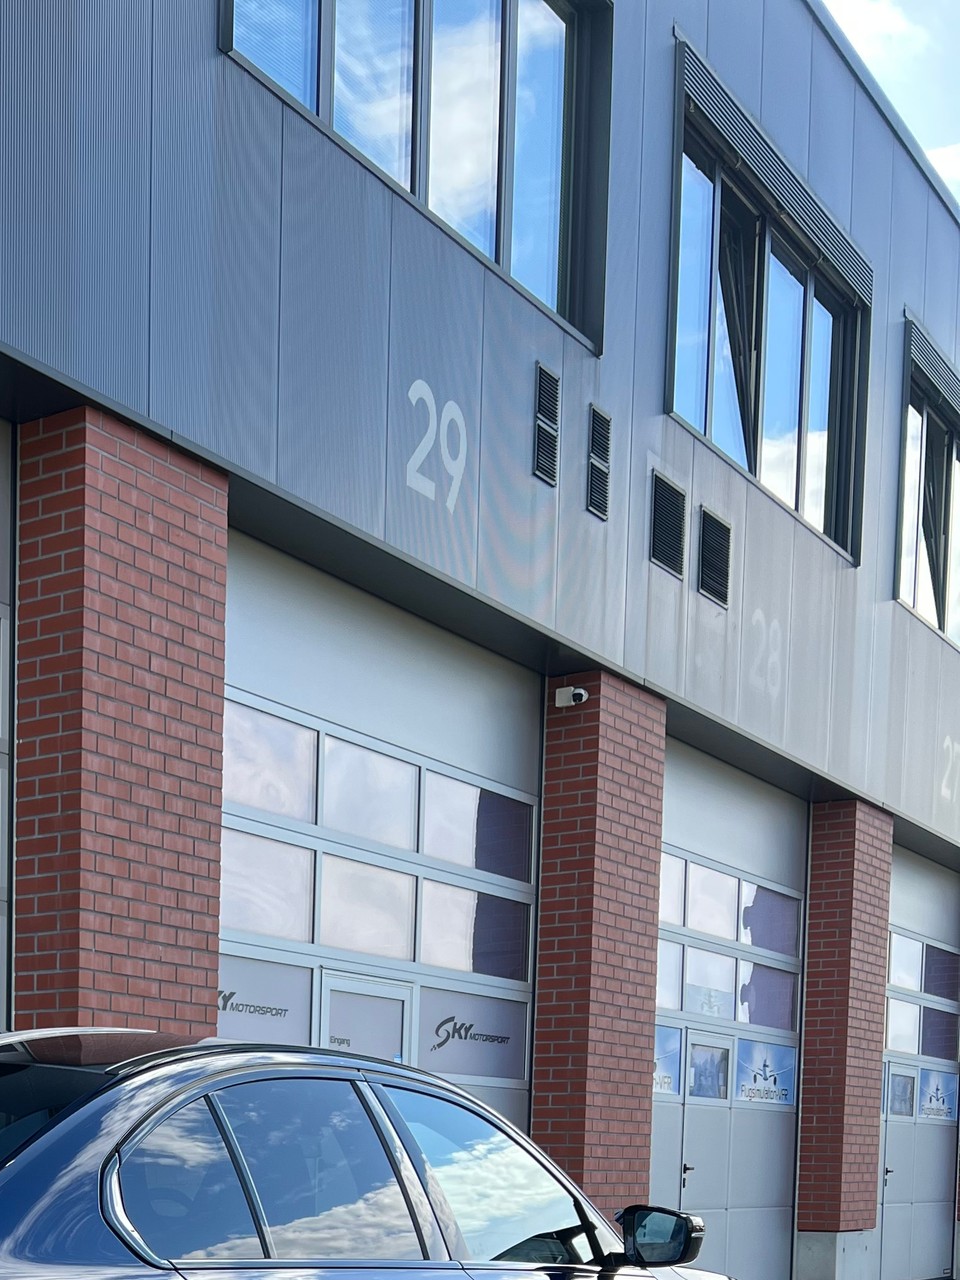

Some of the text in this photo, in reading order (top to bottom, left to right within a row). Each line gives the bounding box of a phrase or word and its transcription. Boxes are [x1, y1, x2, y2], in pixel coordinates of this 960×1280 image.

[406, 379, 468, 516] 29
[749, 607, 781, 699] 28
[229, 1002, 289, 1018] MOTORSPORT
[430, 1015, 511, 1051] SKY MOTORSPORT
